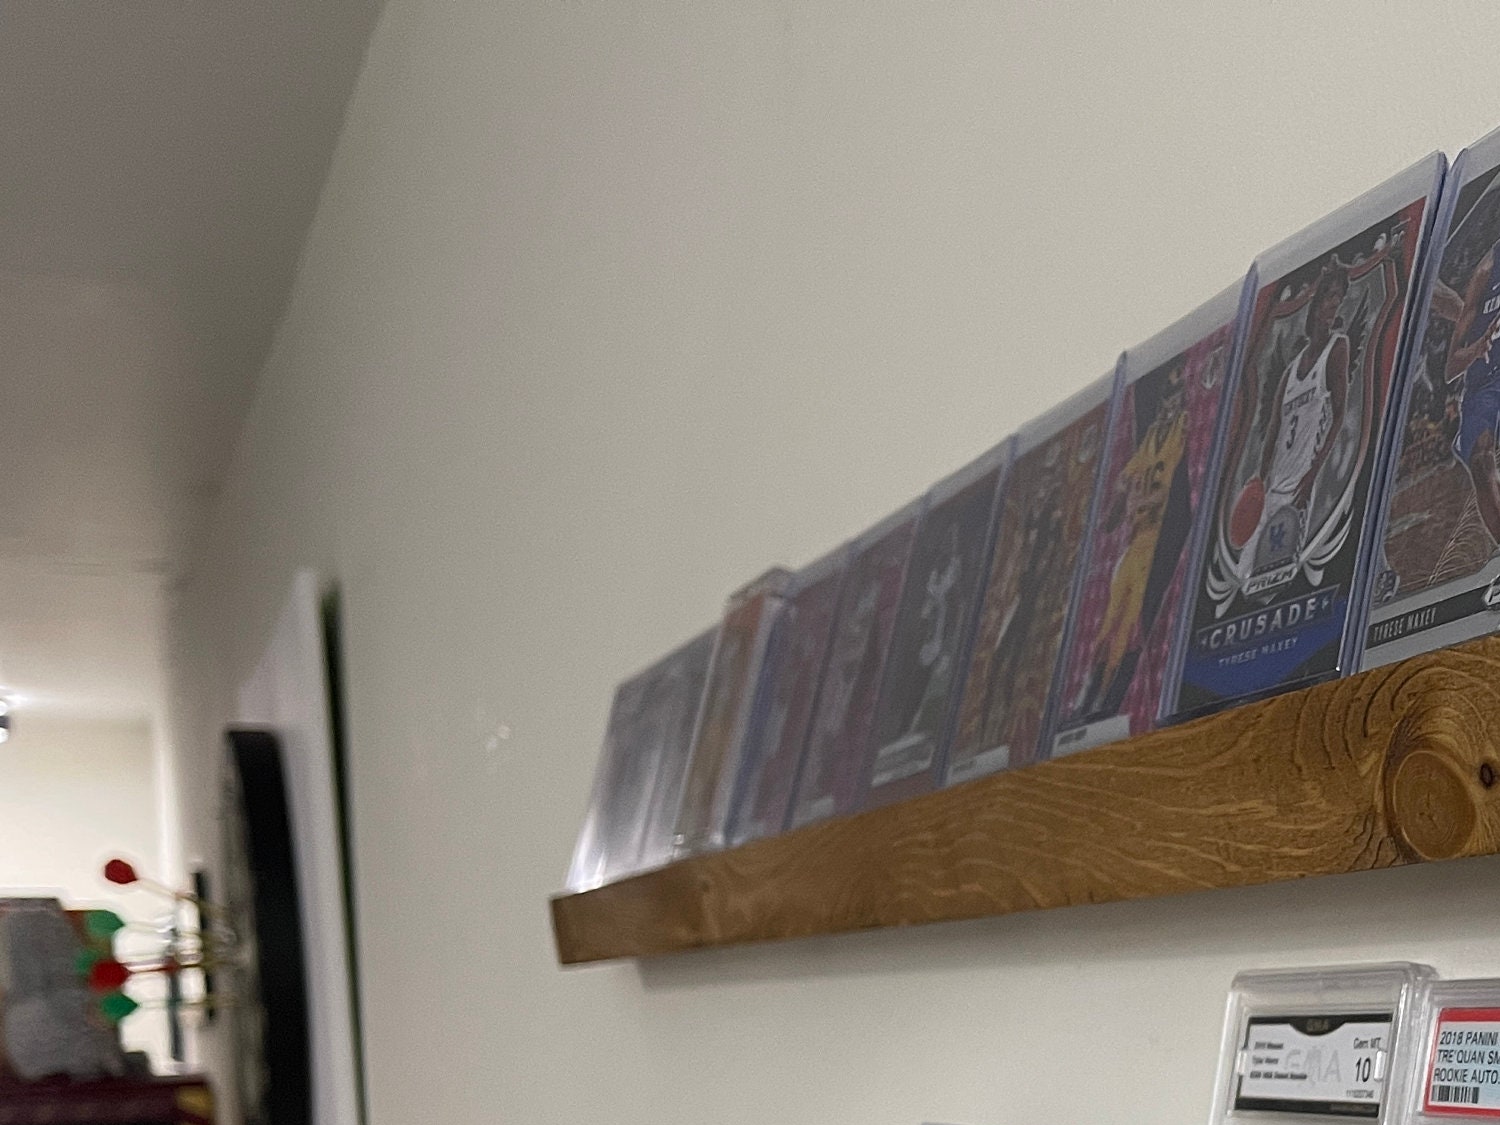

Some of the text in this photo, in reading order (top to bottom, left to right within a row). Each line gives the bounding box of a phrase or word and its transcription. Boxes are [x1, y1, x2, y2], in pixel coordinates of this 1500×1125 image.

[1210, 597, 1316, 649] CRUSADE
[1439, 1031, 1463, 1046] 2018
[1465, 1031, 1499, 1047] PANINI
[1437, 1050, 1485, 1065] TRE'QUAN
[1355, 1057, 1372, 1083] 10
[1434, 1068, 1468, 1084] ROOKIE
